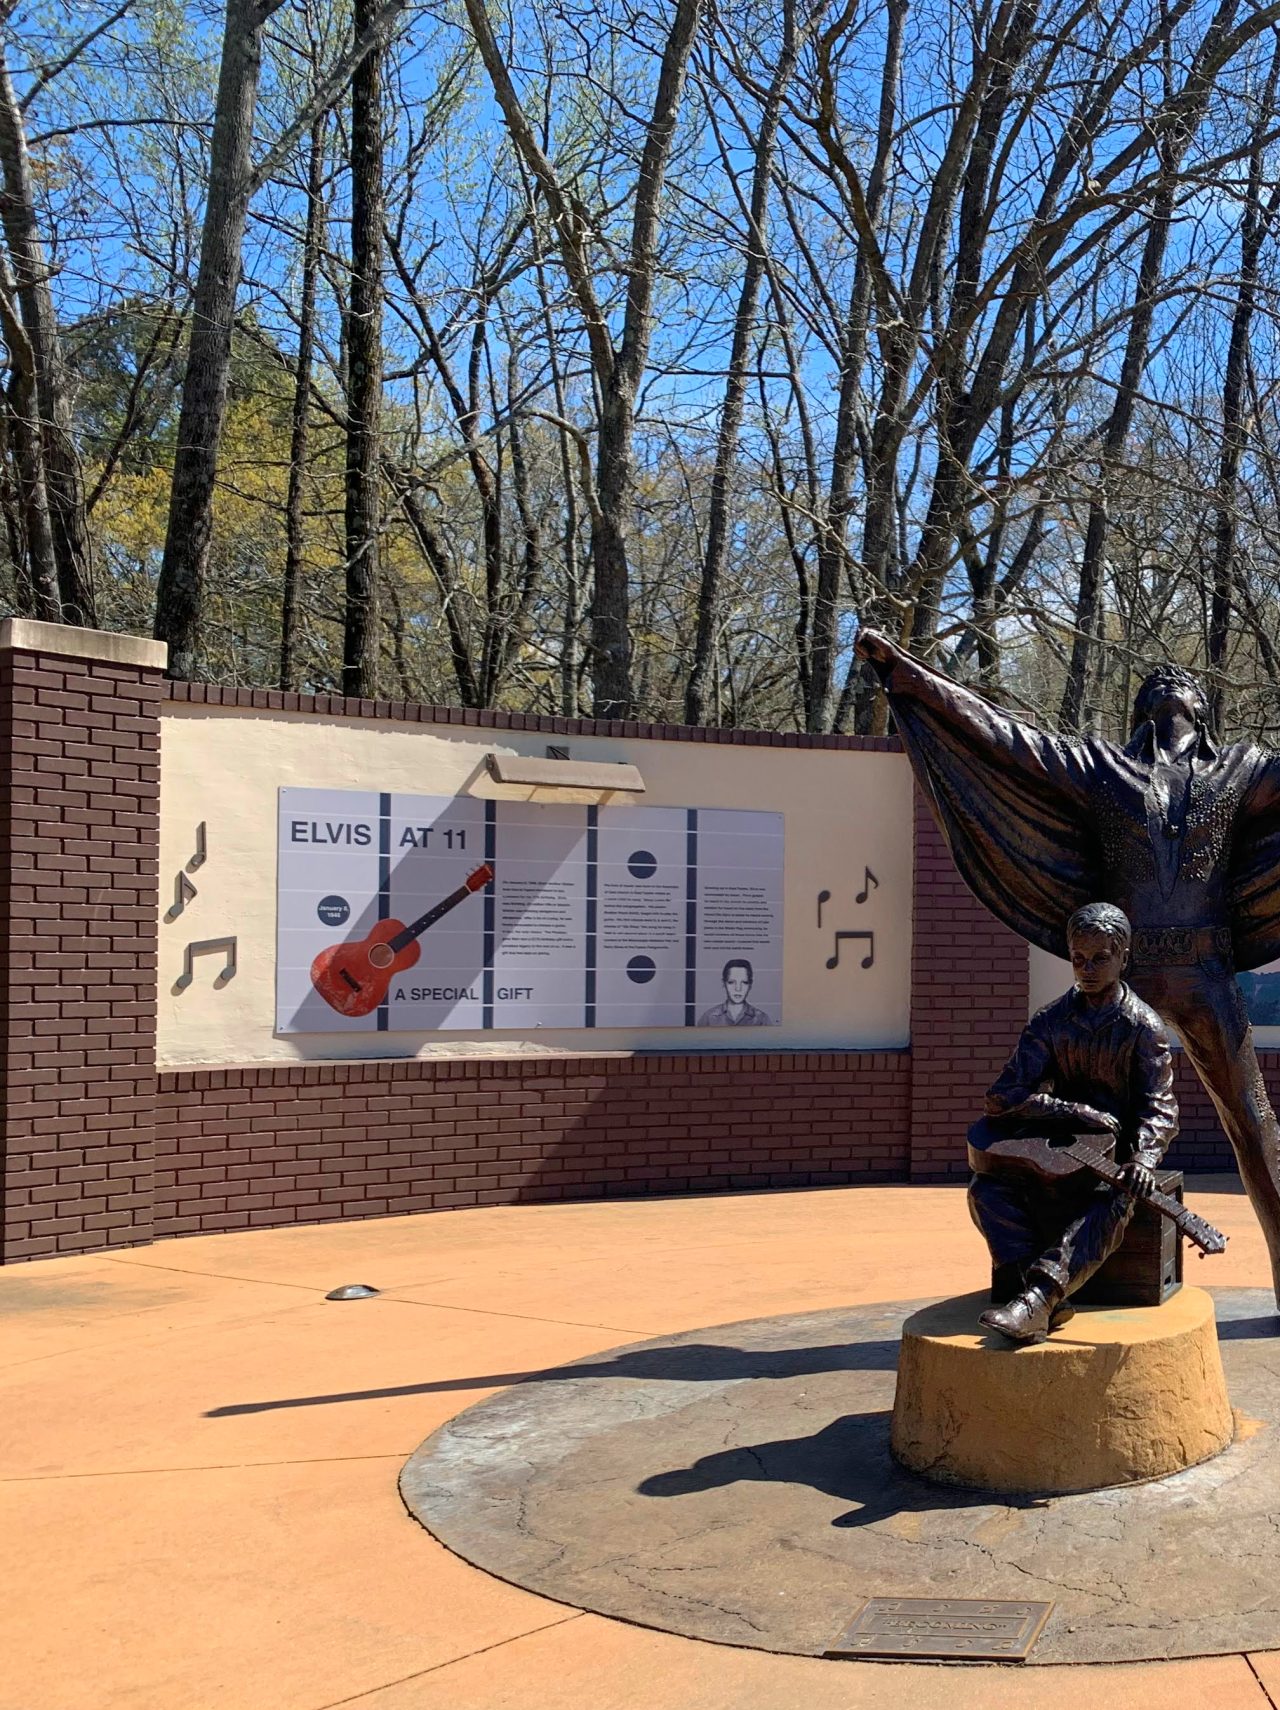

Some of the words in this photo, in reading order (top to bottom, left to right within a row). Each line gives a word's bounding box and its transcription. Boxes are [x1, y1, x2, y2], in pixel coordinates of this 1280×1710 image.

[291, 821, 372, 845] ELVIS
[400, 827, 434, 848] AT
[443, 829, 466, 849] 11
[395, 988, 406, 1000] A
[410, 987, 479, 1000] SPECIAL
[497, 987, 534, 1000] GIFT
